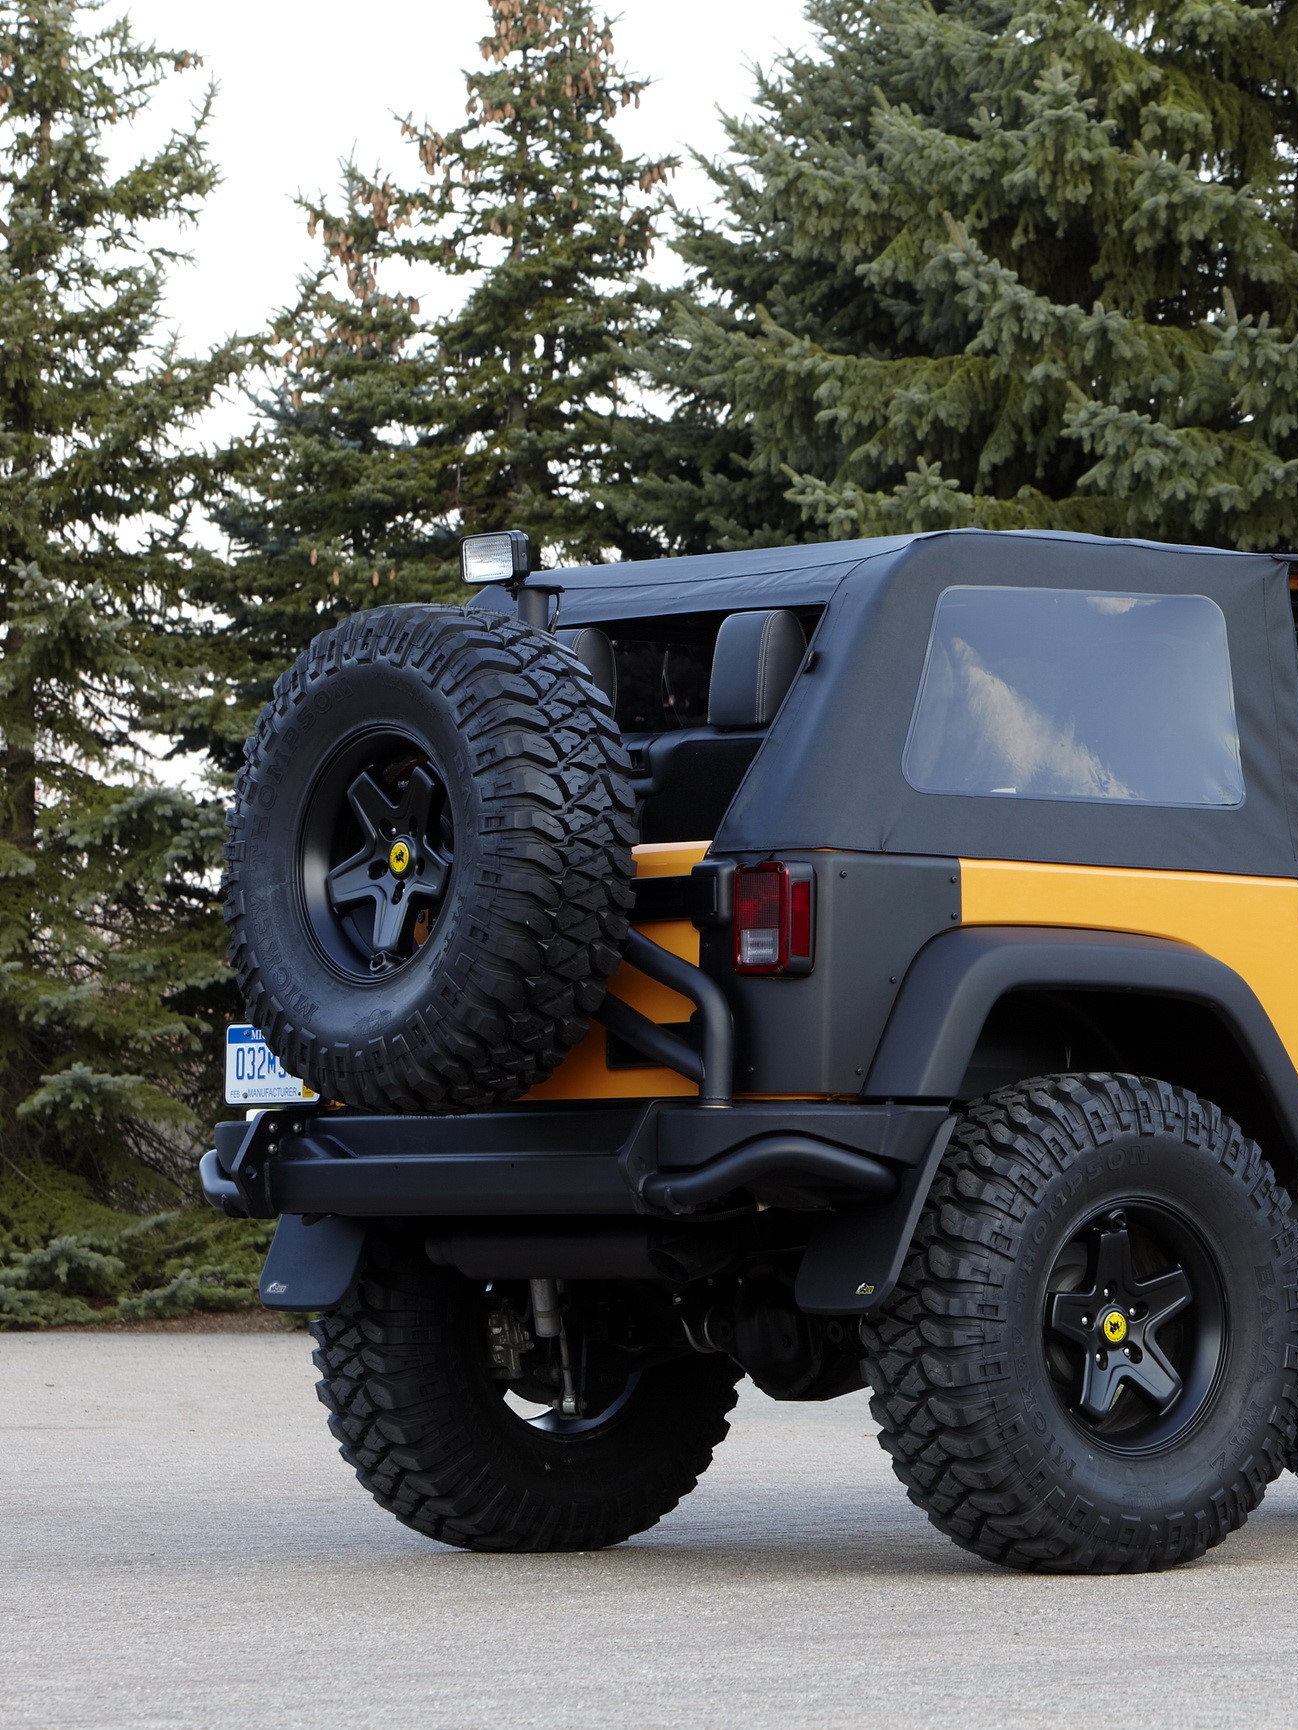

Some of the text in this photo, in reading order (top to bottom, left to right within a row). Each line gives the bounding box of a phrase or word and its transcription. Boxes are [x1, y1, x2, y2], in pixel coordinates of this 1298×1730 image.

[236, 1046, 287, 1080] 032M
[230, 1090, 241, 1099] FEB
[247, 1086, 298, 1098] MANUFACTURER
